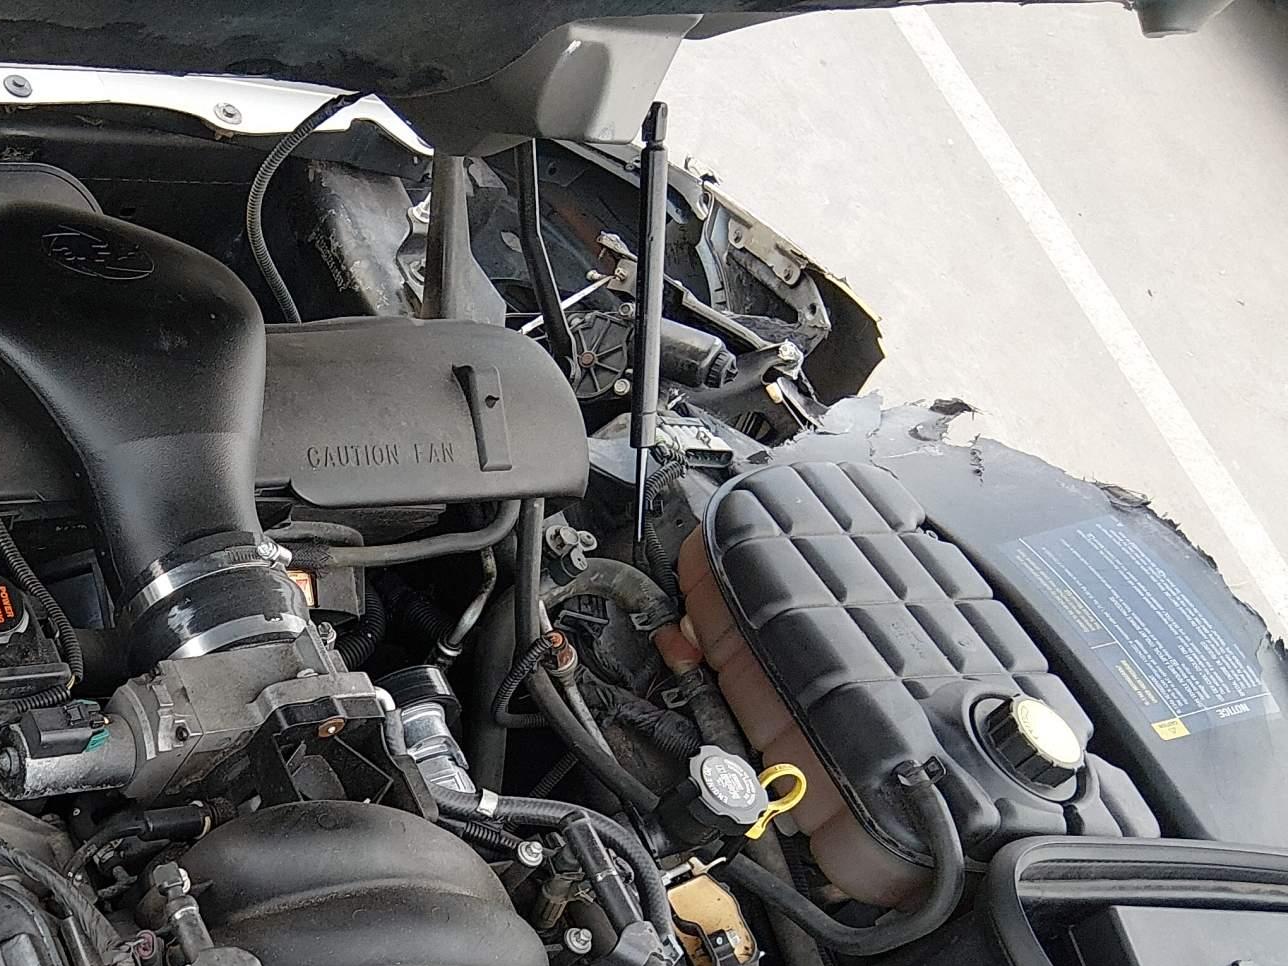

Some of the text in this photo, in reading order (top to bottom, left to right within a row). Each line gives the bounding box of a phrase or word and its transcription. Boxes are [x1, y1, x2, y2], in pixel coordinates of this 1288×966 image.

[307, 442, 454, 469] CAUTION FAN
[1215, 703, 1249, 719] NOTICE
